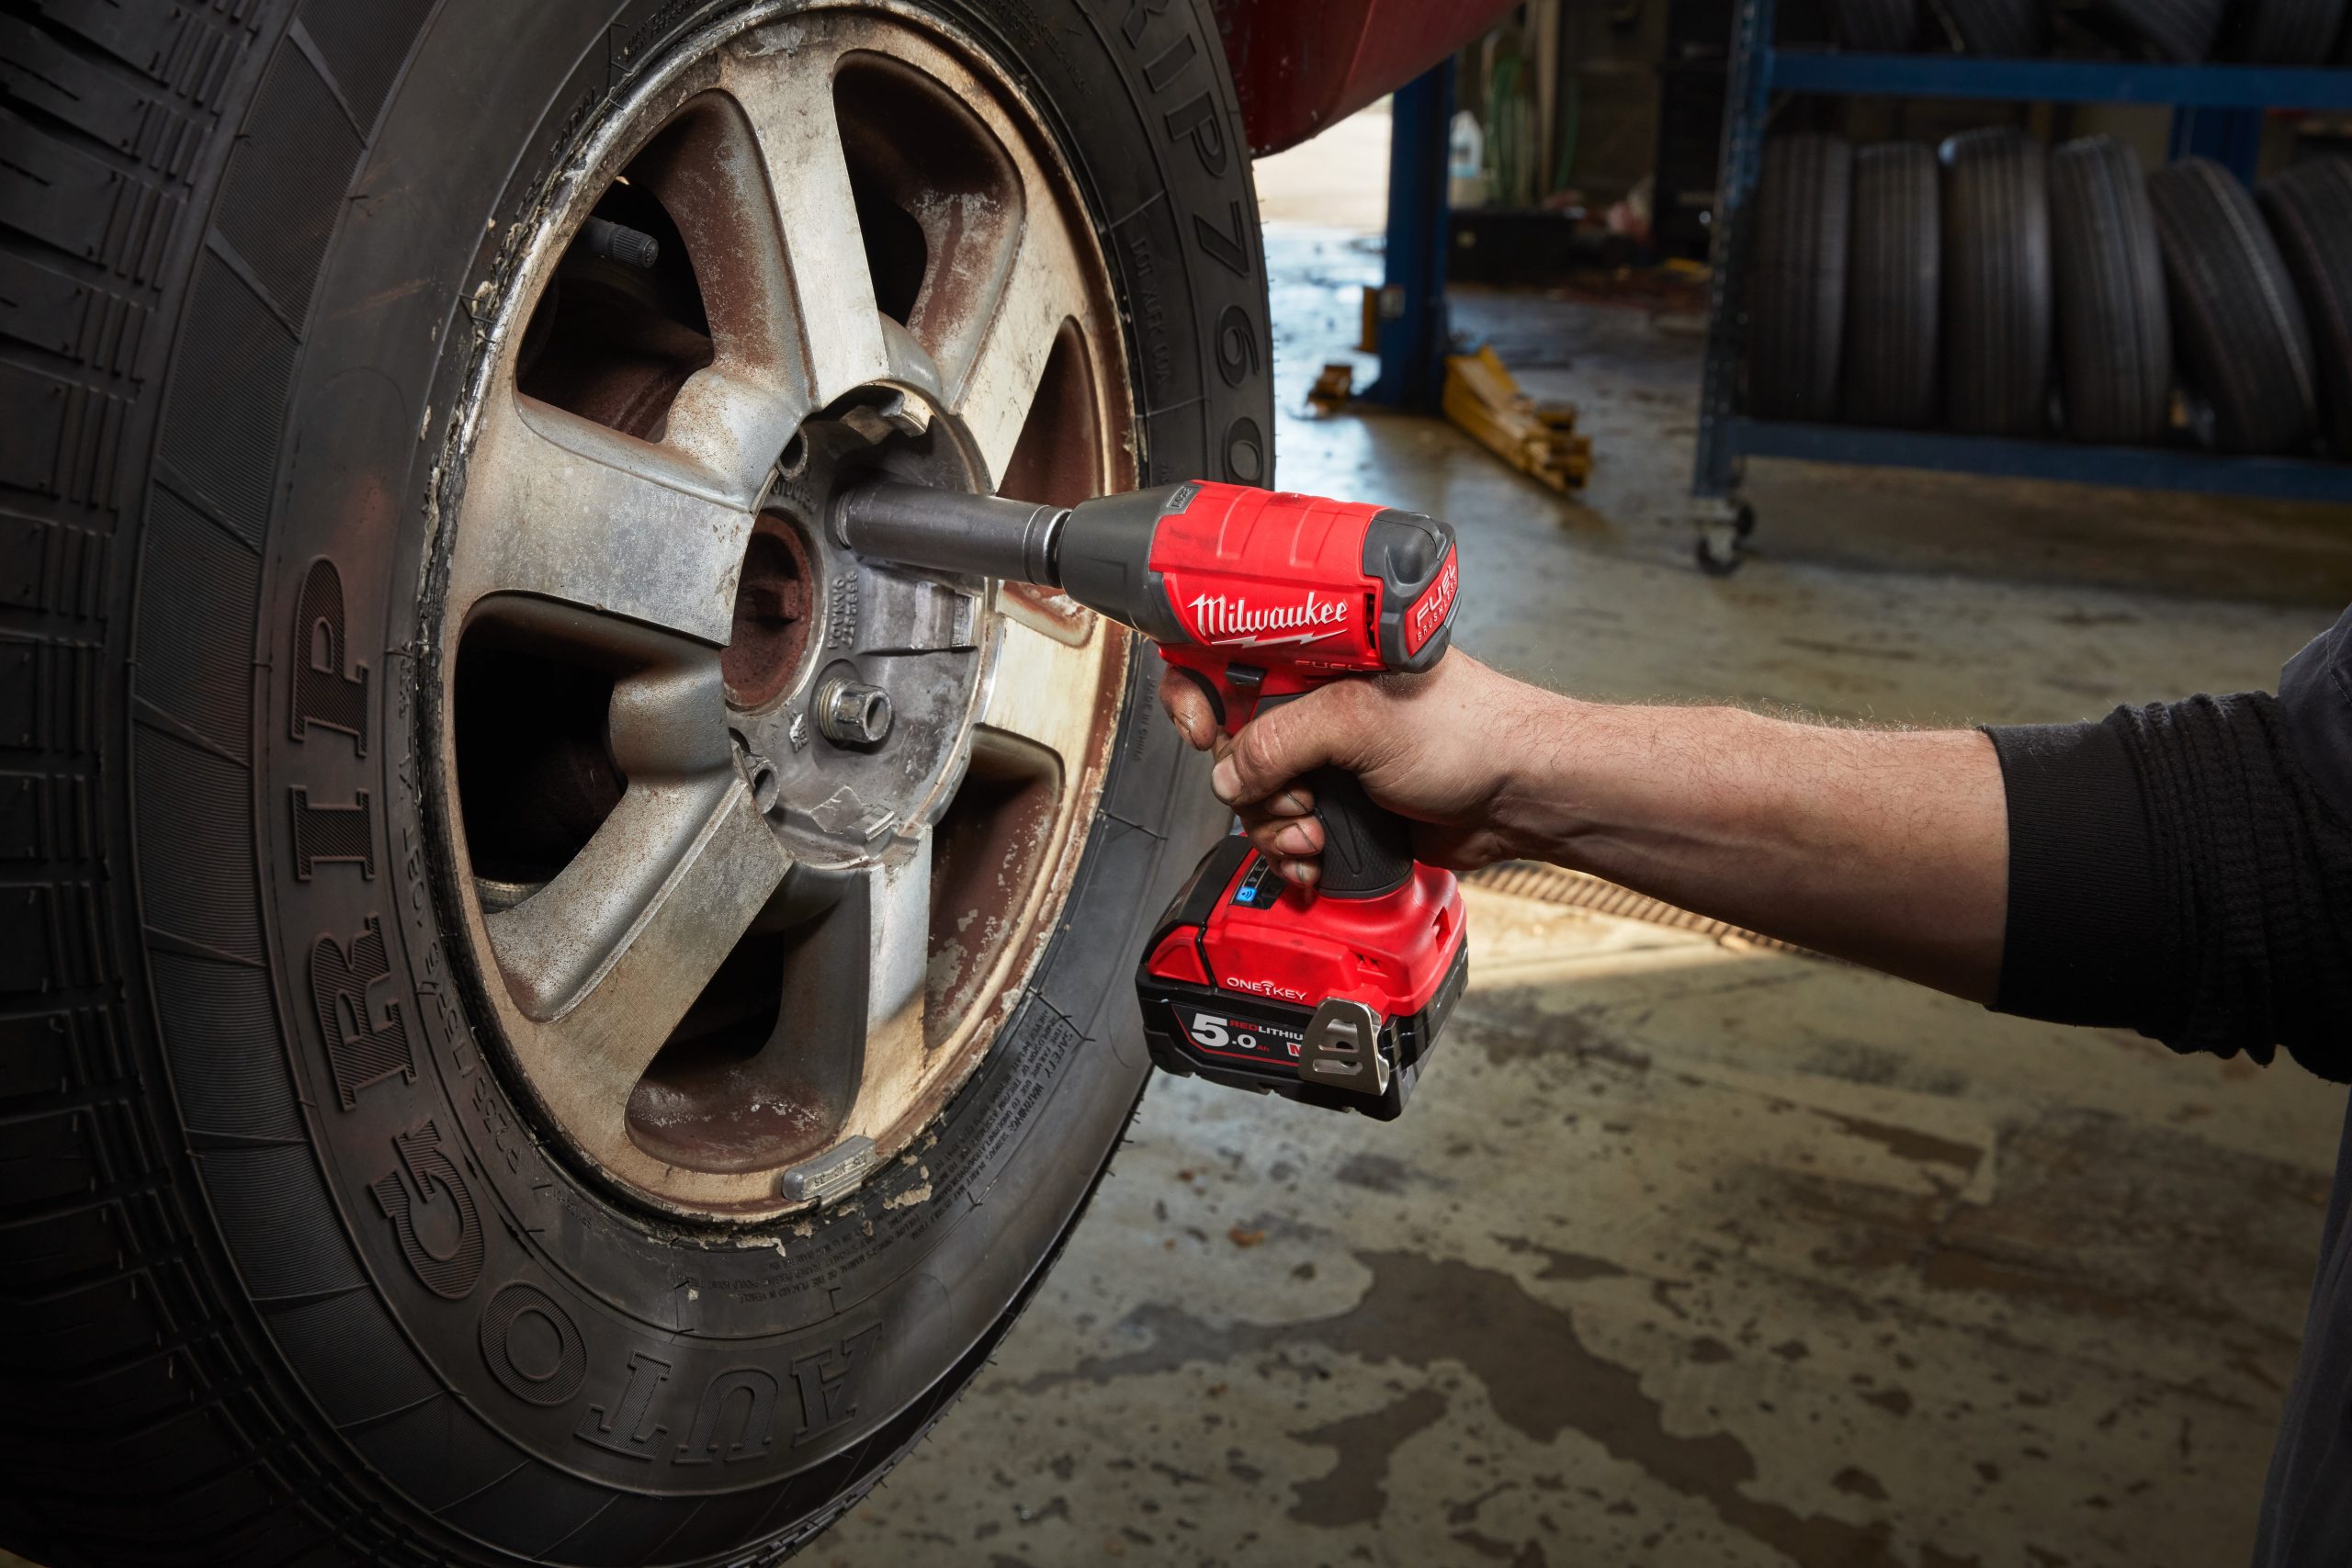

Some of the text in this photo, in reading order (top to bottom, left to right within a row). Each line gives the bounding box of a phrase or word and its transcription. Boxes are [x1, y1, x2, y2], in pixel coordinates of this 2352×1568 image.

[1129, 231, 1154, 286] DOT
[825, 576, 847, 652] CANADA
[1186, 591, 1349, 637] Milwaukee
[1416, 563, 1456, 628] FUEL
[1418, 576, 1456, 642] BRUSHLESS
[1295, 660, 1363, 671] FUEL
[288, 553, 883, 1465] AUTOGRIP
[1191, 1012, 1257, 1049] 5.0
[1042, 1025, 1074, 1081] SAFETY
